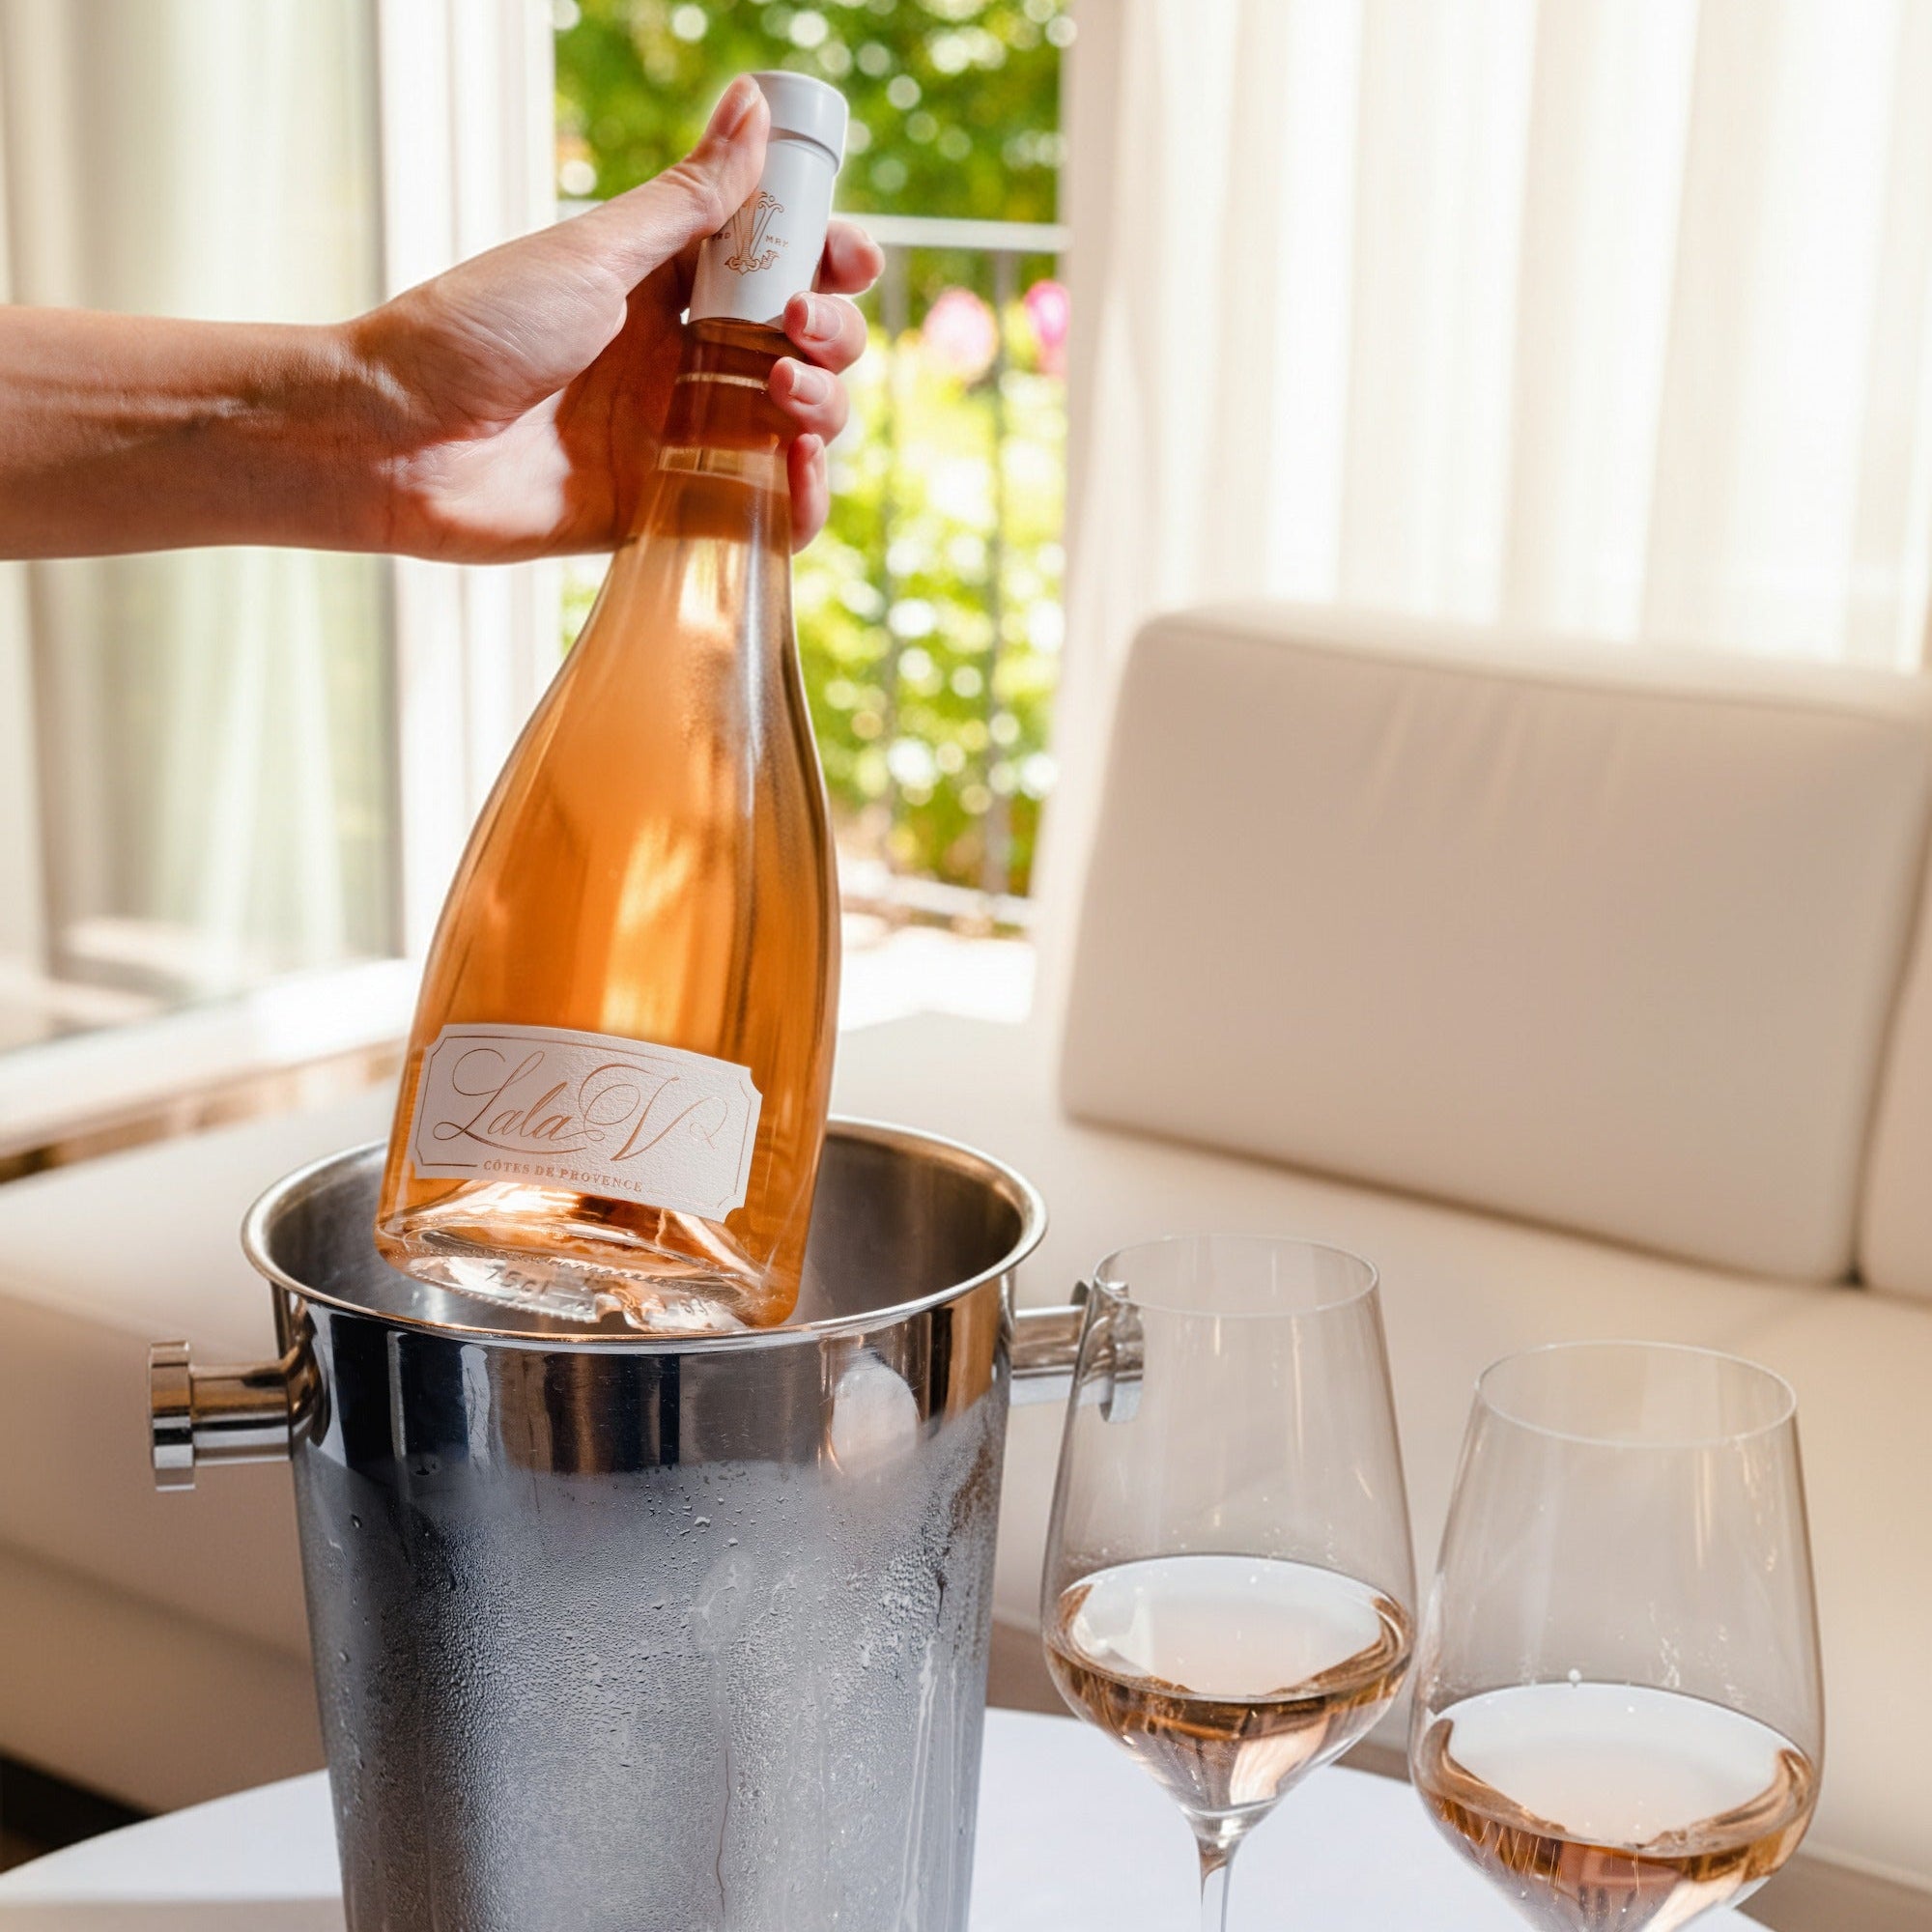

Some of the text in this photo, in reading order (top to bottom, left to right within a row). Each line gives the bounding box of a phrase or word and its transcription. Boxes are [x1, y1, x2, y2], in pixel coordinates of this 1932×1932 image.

[433, 1049, 606, 1154] Lala
[483, 1158, 643, 1193] CÔTES DE PROVENCE
